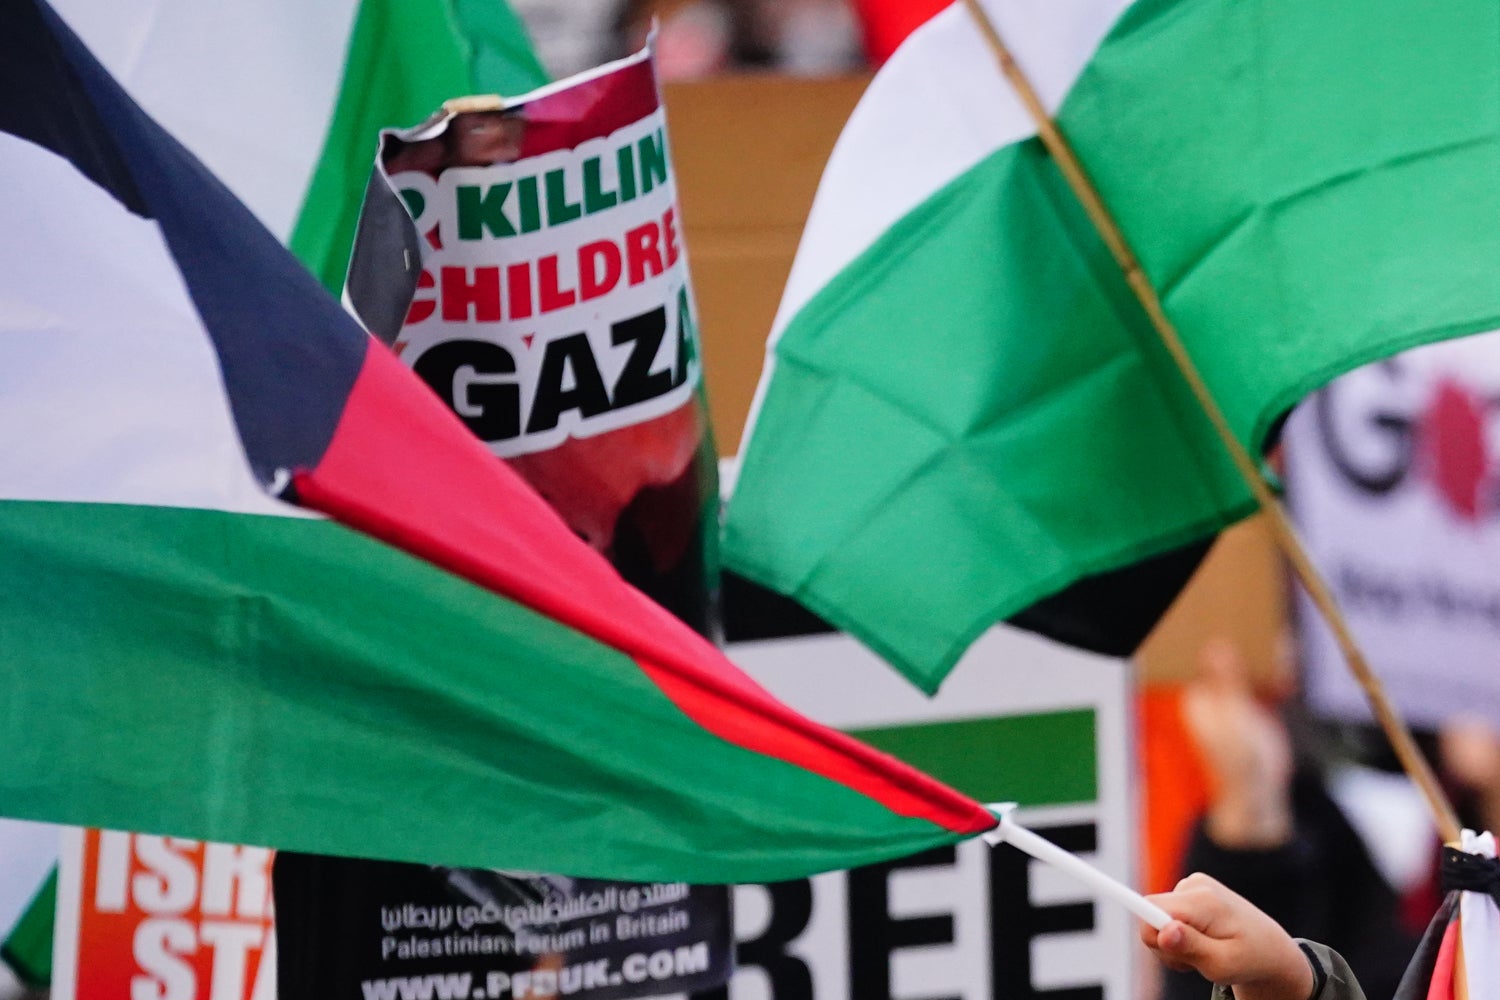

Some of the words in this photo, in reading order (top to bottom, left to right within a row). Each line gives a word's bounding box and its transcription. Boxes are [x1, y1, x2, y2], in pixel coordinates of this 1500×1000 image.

[457, 127, 667, 241] KILLIN
[404, 207, 679, 325] CHILDRE
[412, 284, 698, 442] GAZA
[97, 832, 275, 916] ISR
[381, 932, 507, 960] Palestinian
[590, 920, 610, 944] in
[616, 907, 690, 941] Britain
